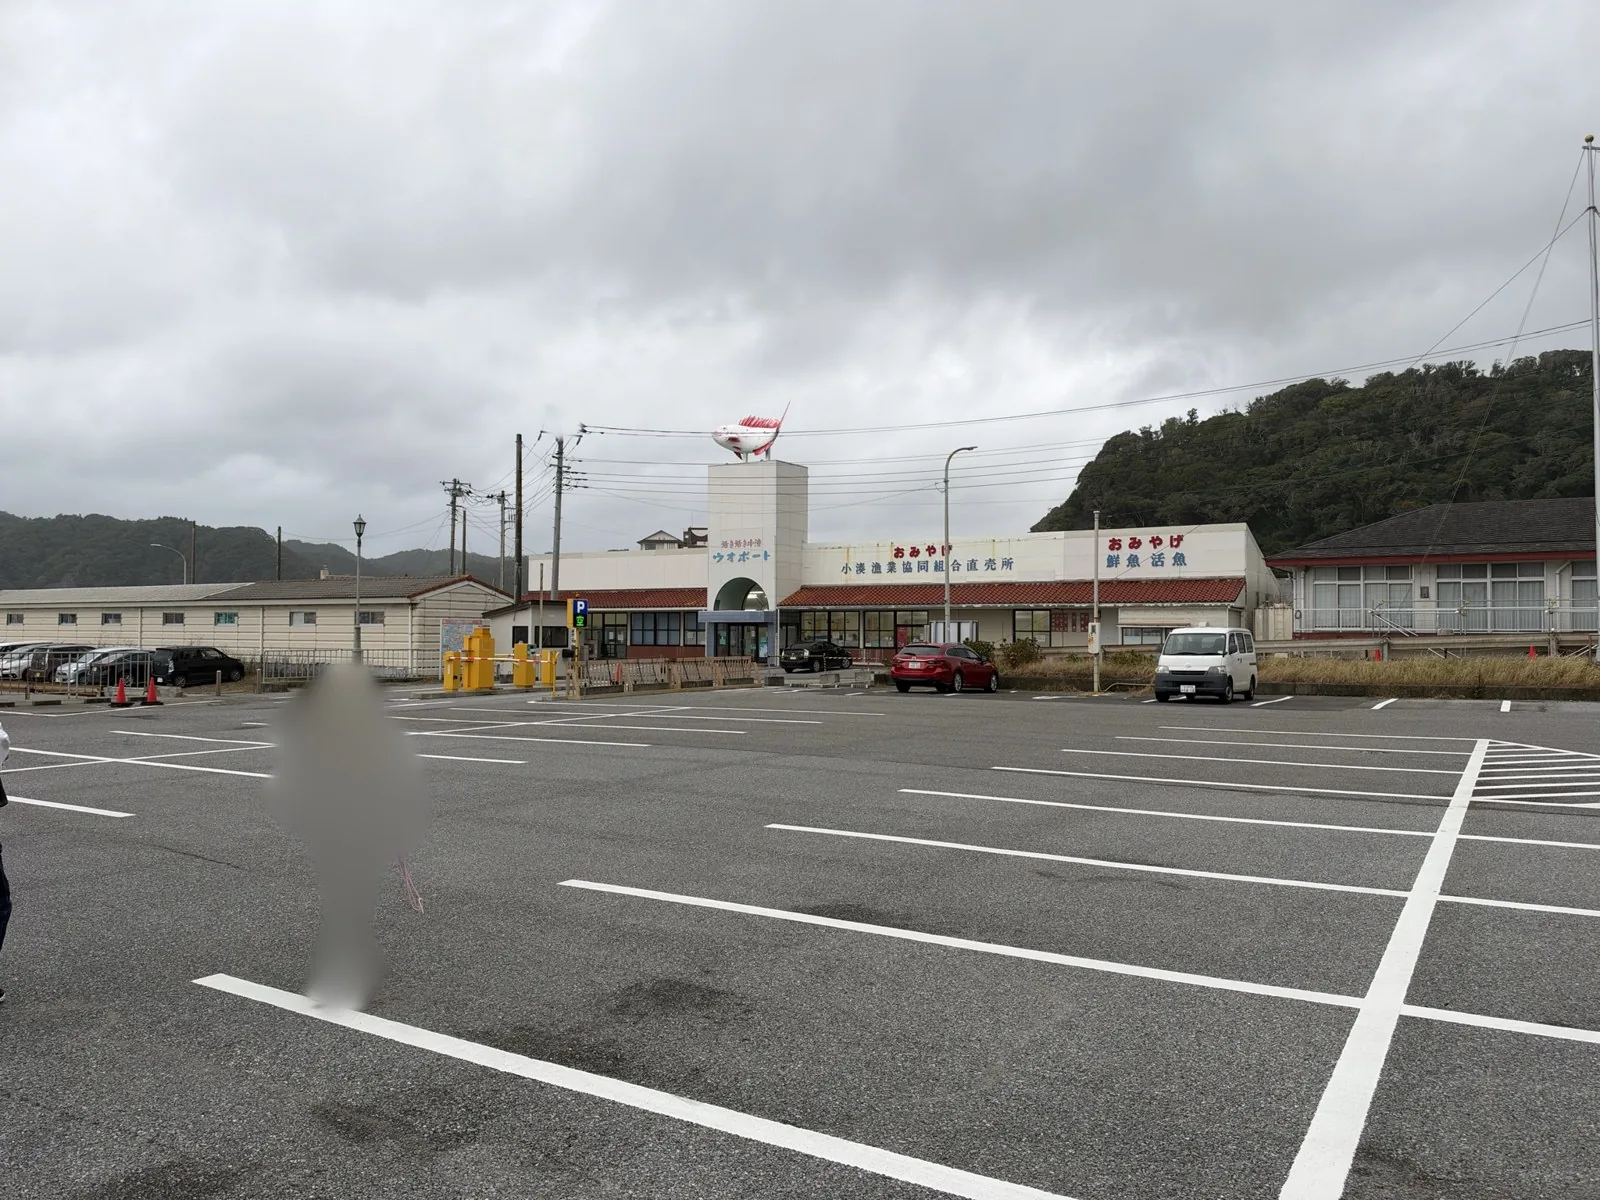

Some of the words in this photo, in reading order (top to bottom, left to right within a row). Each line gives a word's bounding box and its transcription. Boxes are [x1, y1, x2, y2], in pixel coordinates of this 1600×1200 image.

[1108, 534, 1184, 551] おみやげ
[712, 550, 771, 563] ウオポート
[841, 557, 1015, 575] 小湊漁業協同組合直売所
[577, 601, 585, 614] P
[575, 615, 585, 627] 空
